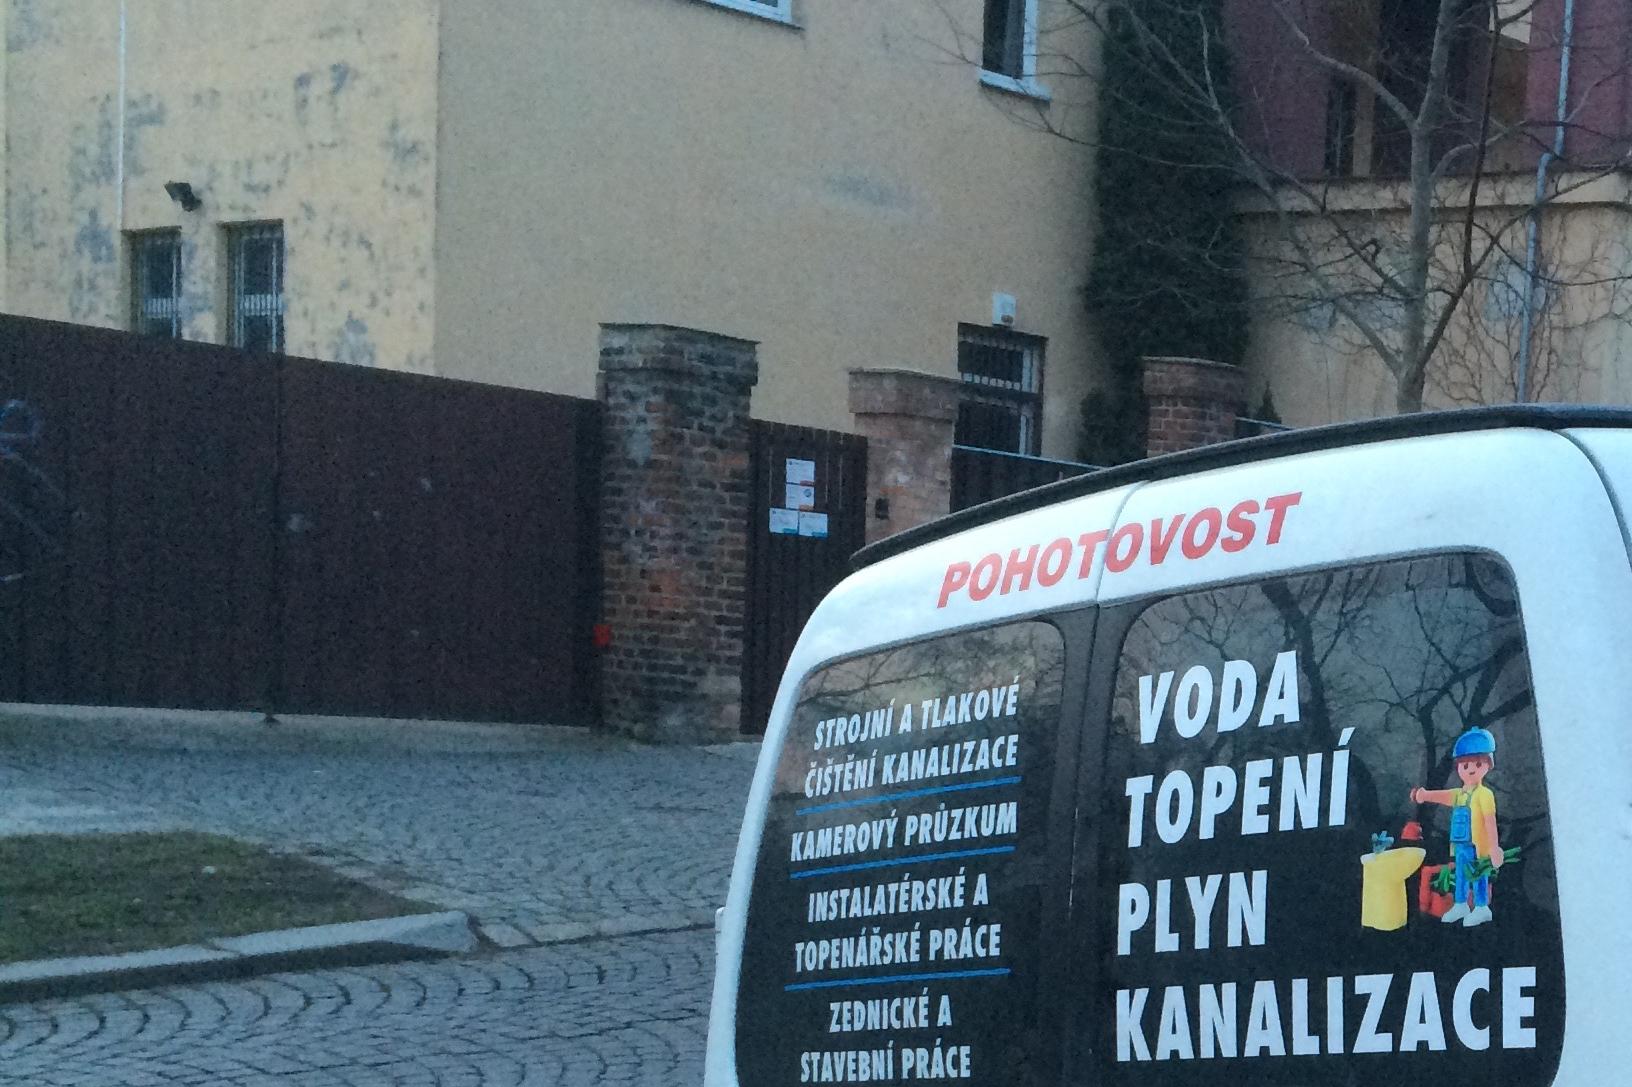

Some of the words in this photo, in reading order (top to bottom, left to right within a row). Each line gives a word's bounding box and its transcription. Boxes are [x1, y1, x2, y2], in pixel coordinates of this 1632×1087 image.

[936, 491, 1302, 609] POHOTOVOST
[813, 698, 895, 751] STROJNÍ
[899, 703, 912, 734] A
[921, 676, 1020, 731] TLAKOVÉ
[1138, 650, 1300, 744] VODA
[804, 749, 877, 799] ČIŠTĚNÍ
[881, 734, 1019, 785] KANALIZACE
[1124, 727, 1356, 848] TOPENÍ
[790, 812, 898, 862] KAMEROVÝ
[904, 803, 1018, 848] PRŮZKUM
[807, 867, 966, 923] INSTALATÉRSKÉ
[973, 873, 989, 906] A
[1116, 869, 1268, 956] PLYN
[795, 921, 921, 974] TOPENÁŘSKÉ
[929, 917, 1001, 963] PRÁCE
[829, 987, 929, 1034] ZEDNICKÉ
[937, 994, 953, 1028] A
[1115, 965, 1538, 1064] KANALIZACE
[800, 1040, 893, 1083] STAVEBNÍ
[901, 1037, 972, 1080] PRÁCE
